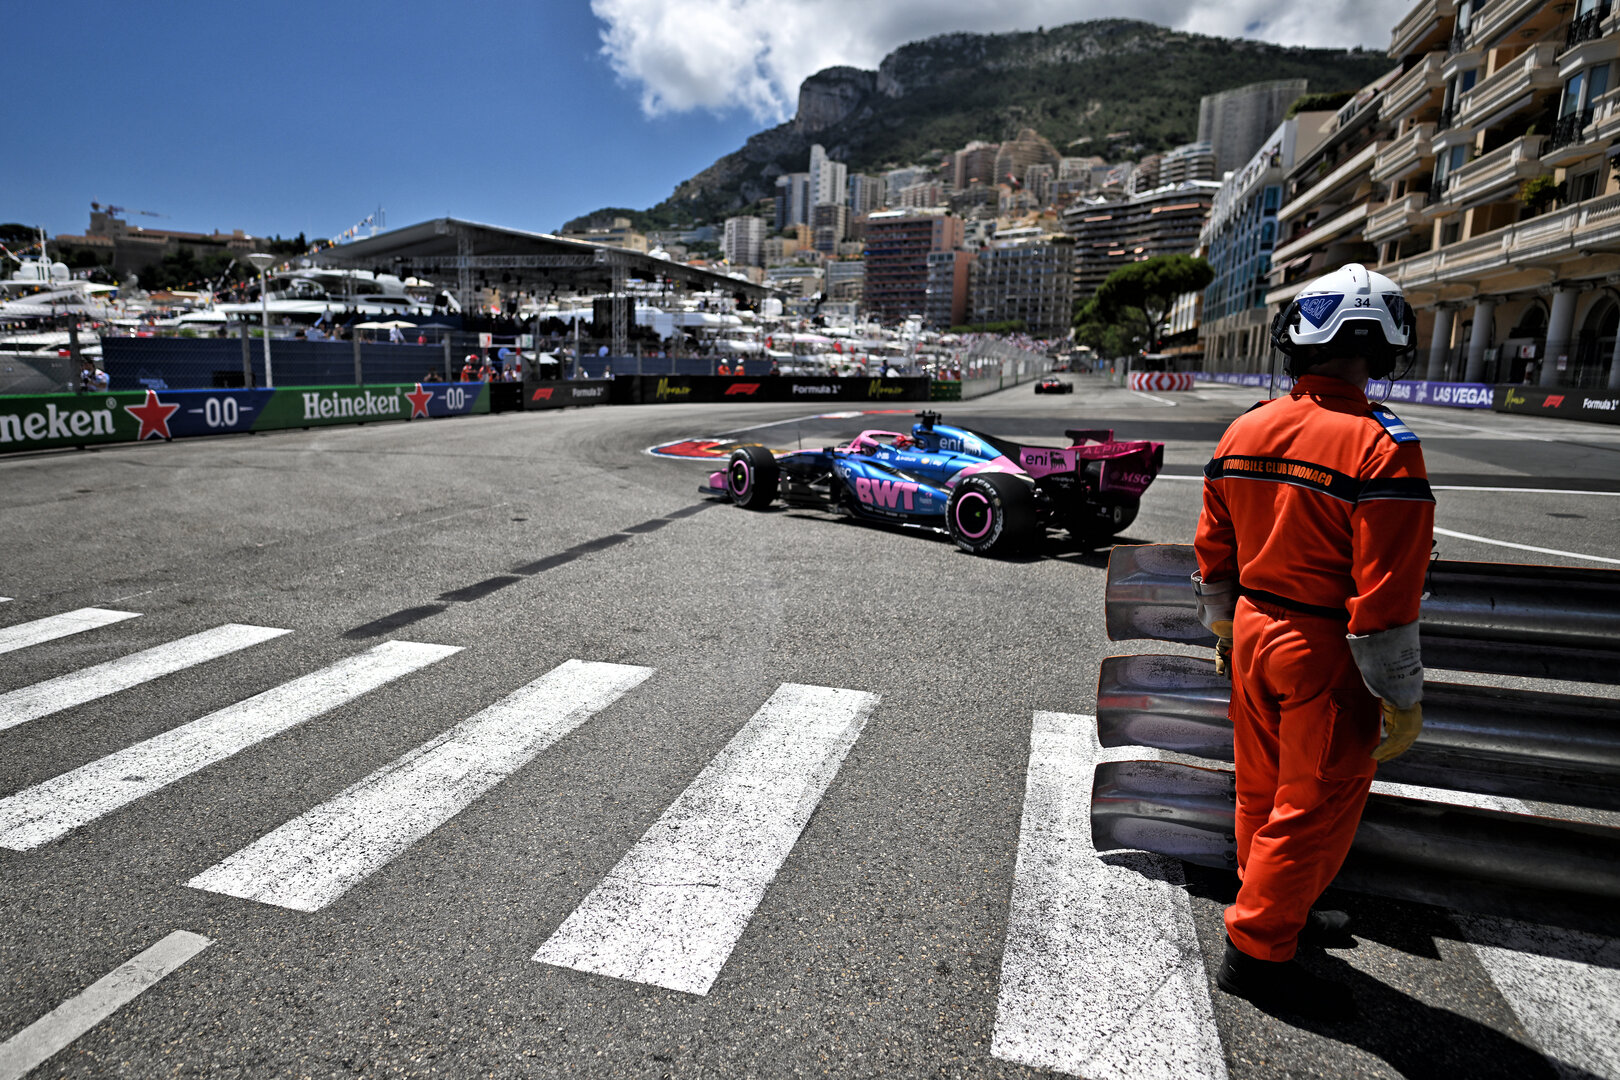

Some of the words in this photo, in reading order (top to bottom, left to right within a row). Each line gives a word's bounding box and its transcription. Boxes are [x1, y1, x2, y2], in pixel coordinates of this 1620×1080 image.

[1301, 298, 1334, 320] ACM
[1354, 298, 1371, 308] 34
[792, 384, 831, 394] Formula
[1433, 386, 1451, 403] LAS
[1452, 387, 1494, 405] VEGAS
[302, 390, 401, 420] Heineken
[1583, 397, 1610, 410] Formula
[939, 436, 961, 451] eni
[1025, 452, 1048, 466] eni
[1120, 471, 1152, 485] MSC
[1266, 461, 1287, 475] CLUB
[1292, 464, 1333, 487] MONACO
[856, 477, 919, 510] BWT
